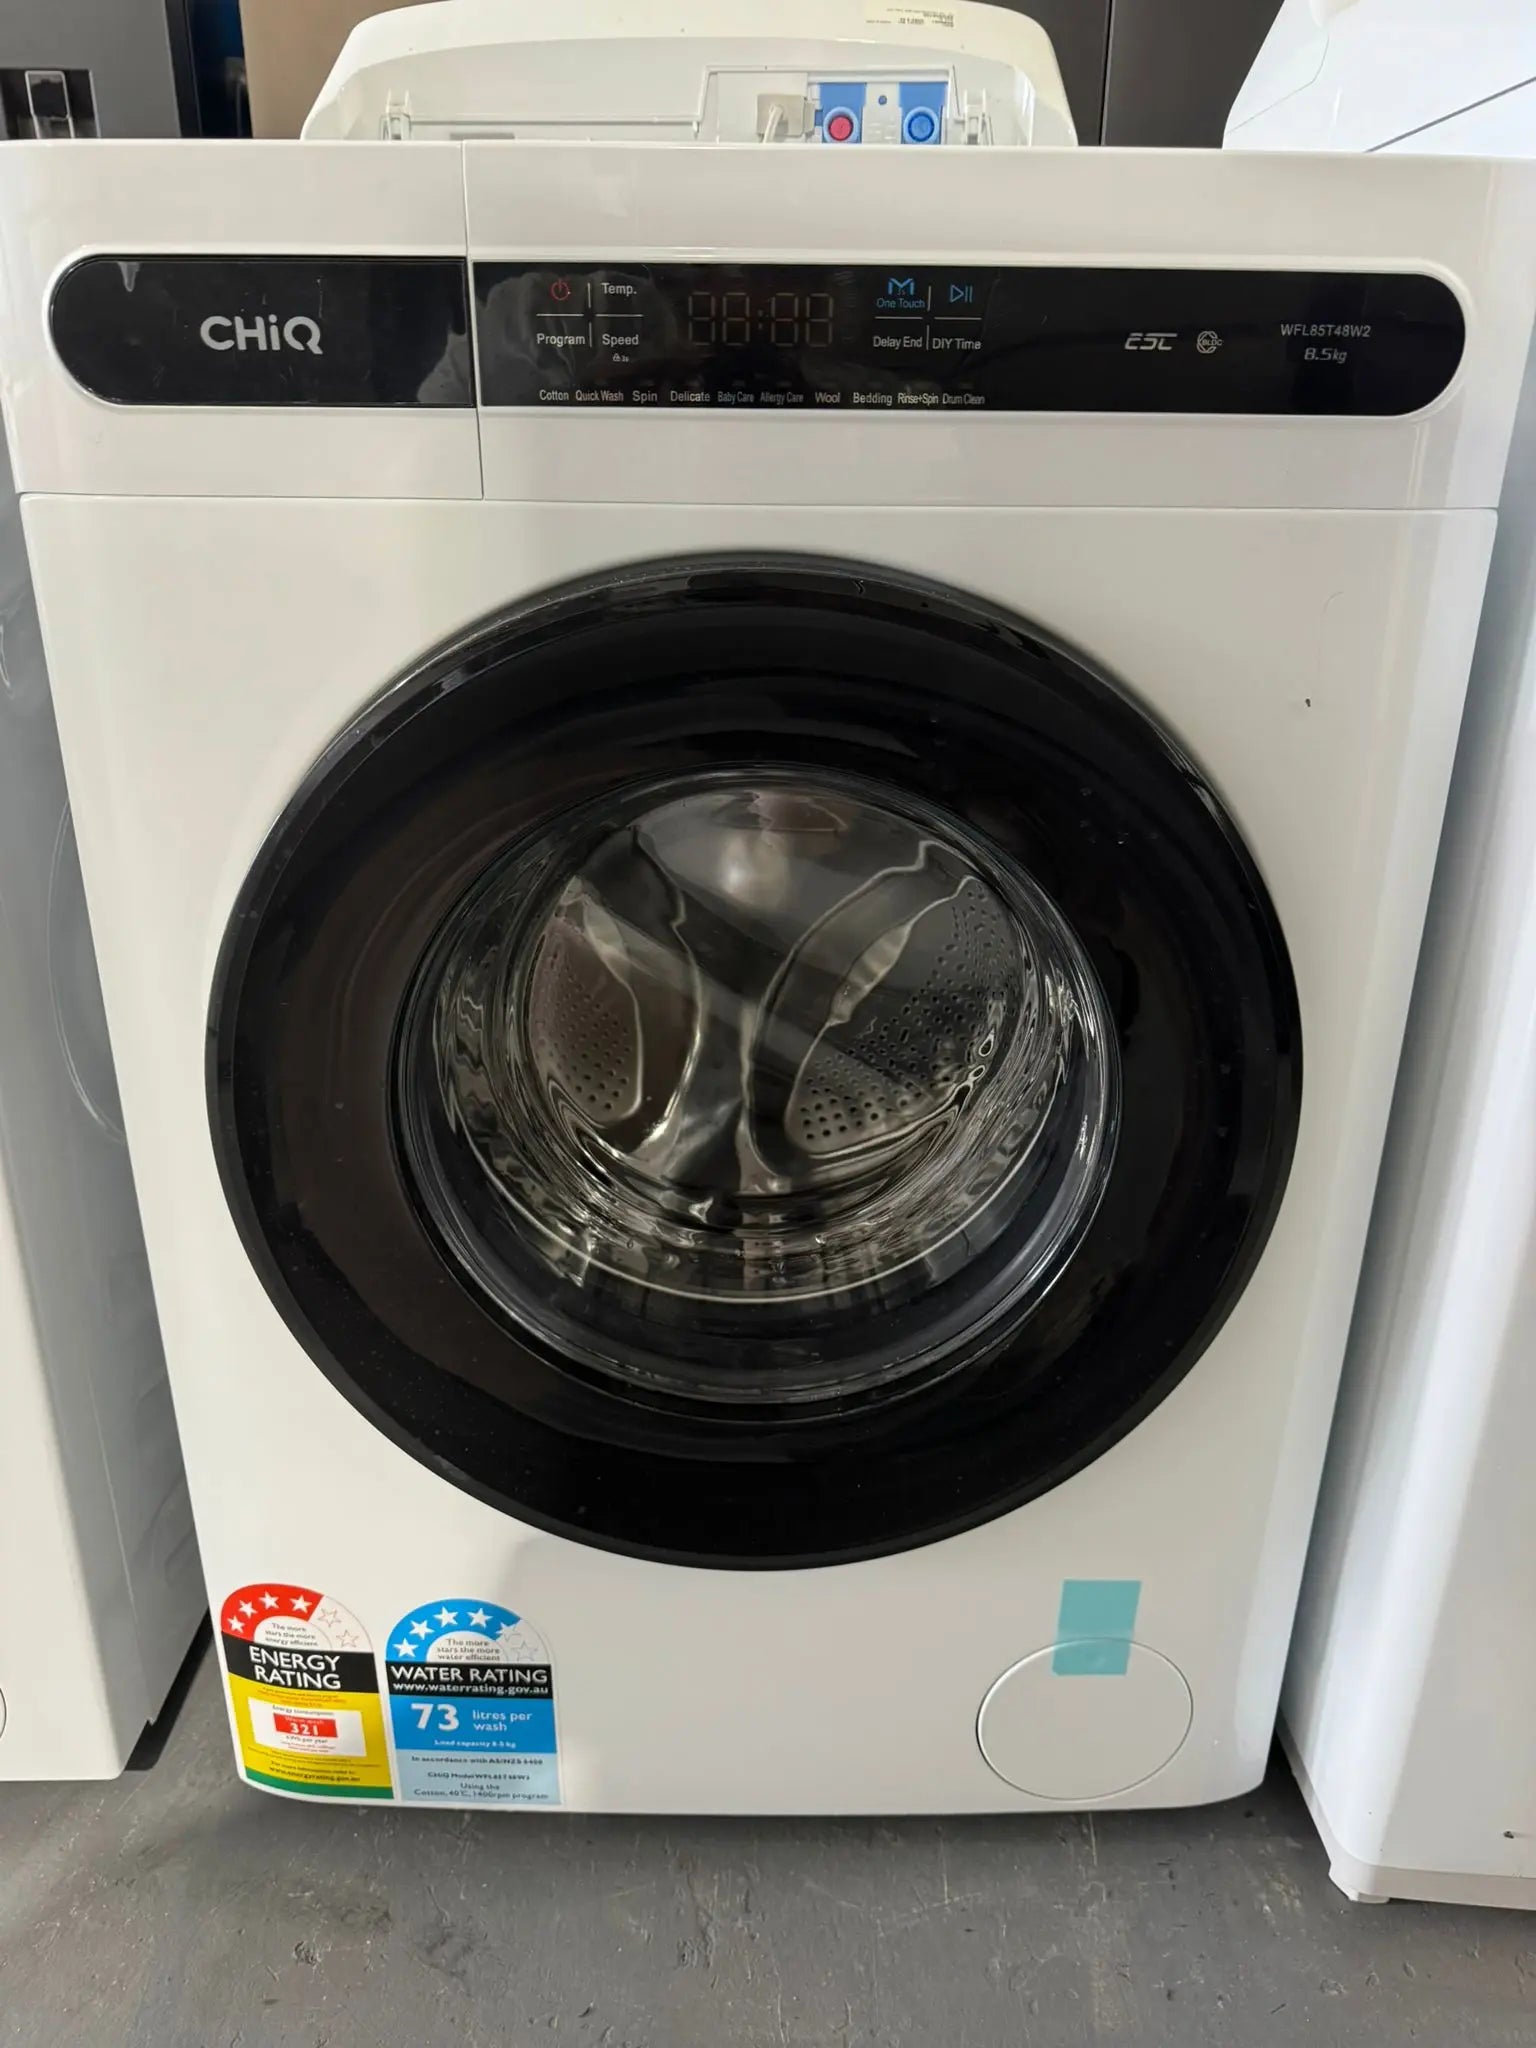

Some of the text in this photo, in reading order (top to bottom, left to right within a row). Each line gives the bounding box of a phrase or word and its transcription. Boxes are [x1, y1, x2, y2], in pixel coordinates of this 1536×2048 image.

[601, 282, 637, 296] Temp.
[876, 297, 925, 308] One Touch
[200, 314, 323, 354] CHiQ
[1280, 324, 1371, 338] WFL85T48W2
[536, 333, 586, 347] Program
[602, 333, 639, 347] Speed
[873, 336, 922, 349] Delay End
[932, 337, 982, 350] DIY Time
[539, 389, 569, 401] Cotton
[575, 389, 599, 401] Quick
[600, 390, 624, 401] Wash
[632, 390, 658, 404] Spin
[670, 390, 711, 402] Delicate
[717, 391, 736, 405] Baby
[737, 391, 754, 402] Care
[760, 391, 786, 406] Allergy
[786, 391, 804, 403] Care
[815, 392, 841, 403] Wool
[853, 392, 893, 406] Bedding
[898, 392, 939, 406] Rinse+Spin
[942, 393, 962, 404] Drum
[271, 1622, 285, 1631] The
[265, 1629, 282, 1638] stars
[265, 1637, 289, 1646] energy
[445, 1638, 464, 1646] The
[249, 1646, 341, 1672] ENERGY
[254, 1665, 342, 1690] RATING
[391, 1665, 548, 1684] WATER RATING
[393, 1682, 549, 1695] www.waterrating.gov.au
[411, 1703, 459, 1731] 73
[472, 1710, 533, 1723] litres per
[290, 1722, 319, 1736] 321
[473, 1722, 507, 1732] wash
[460, 1782, 484, 1790] Using
[512, 1792, 549, 1800] program
